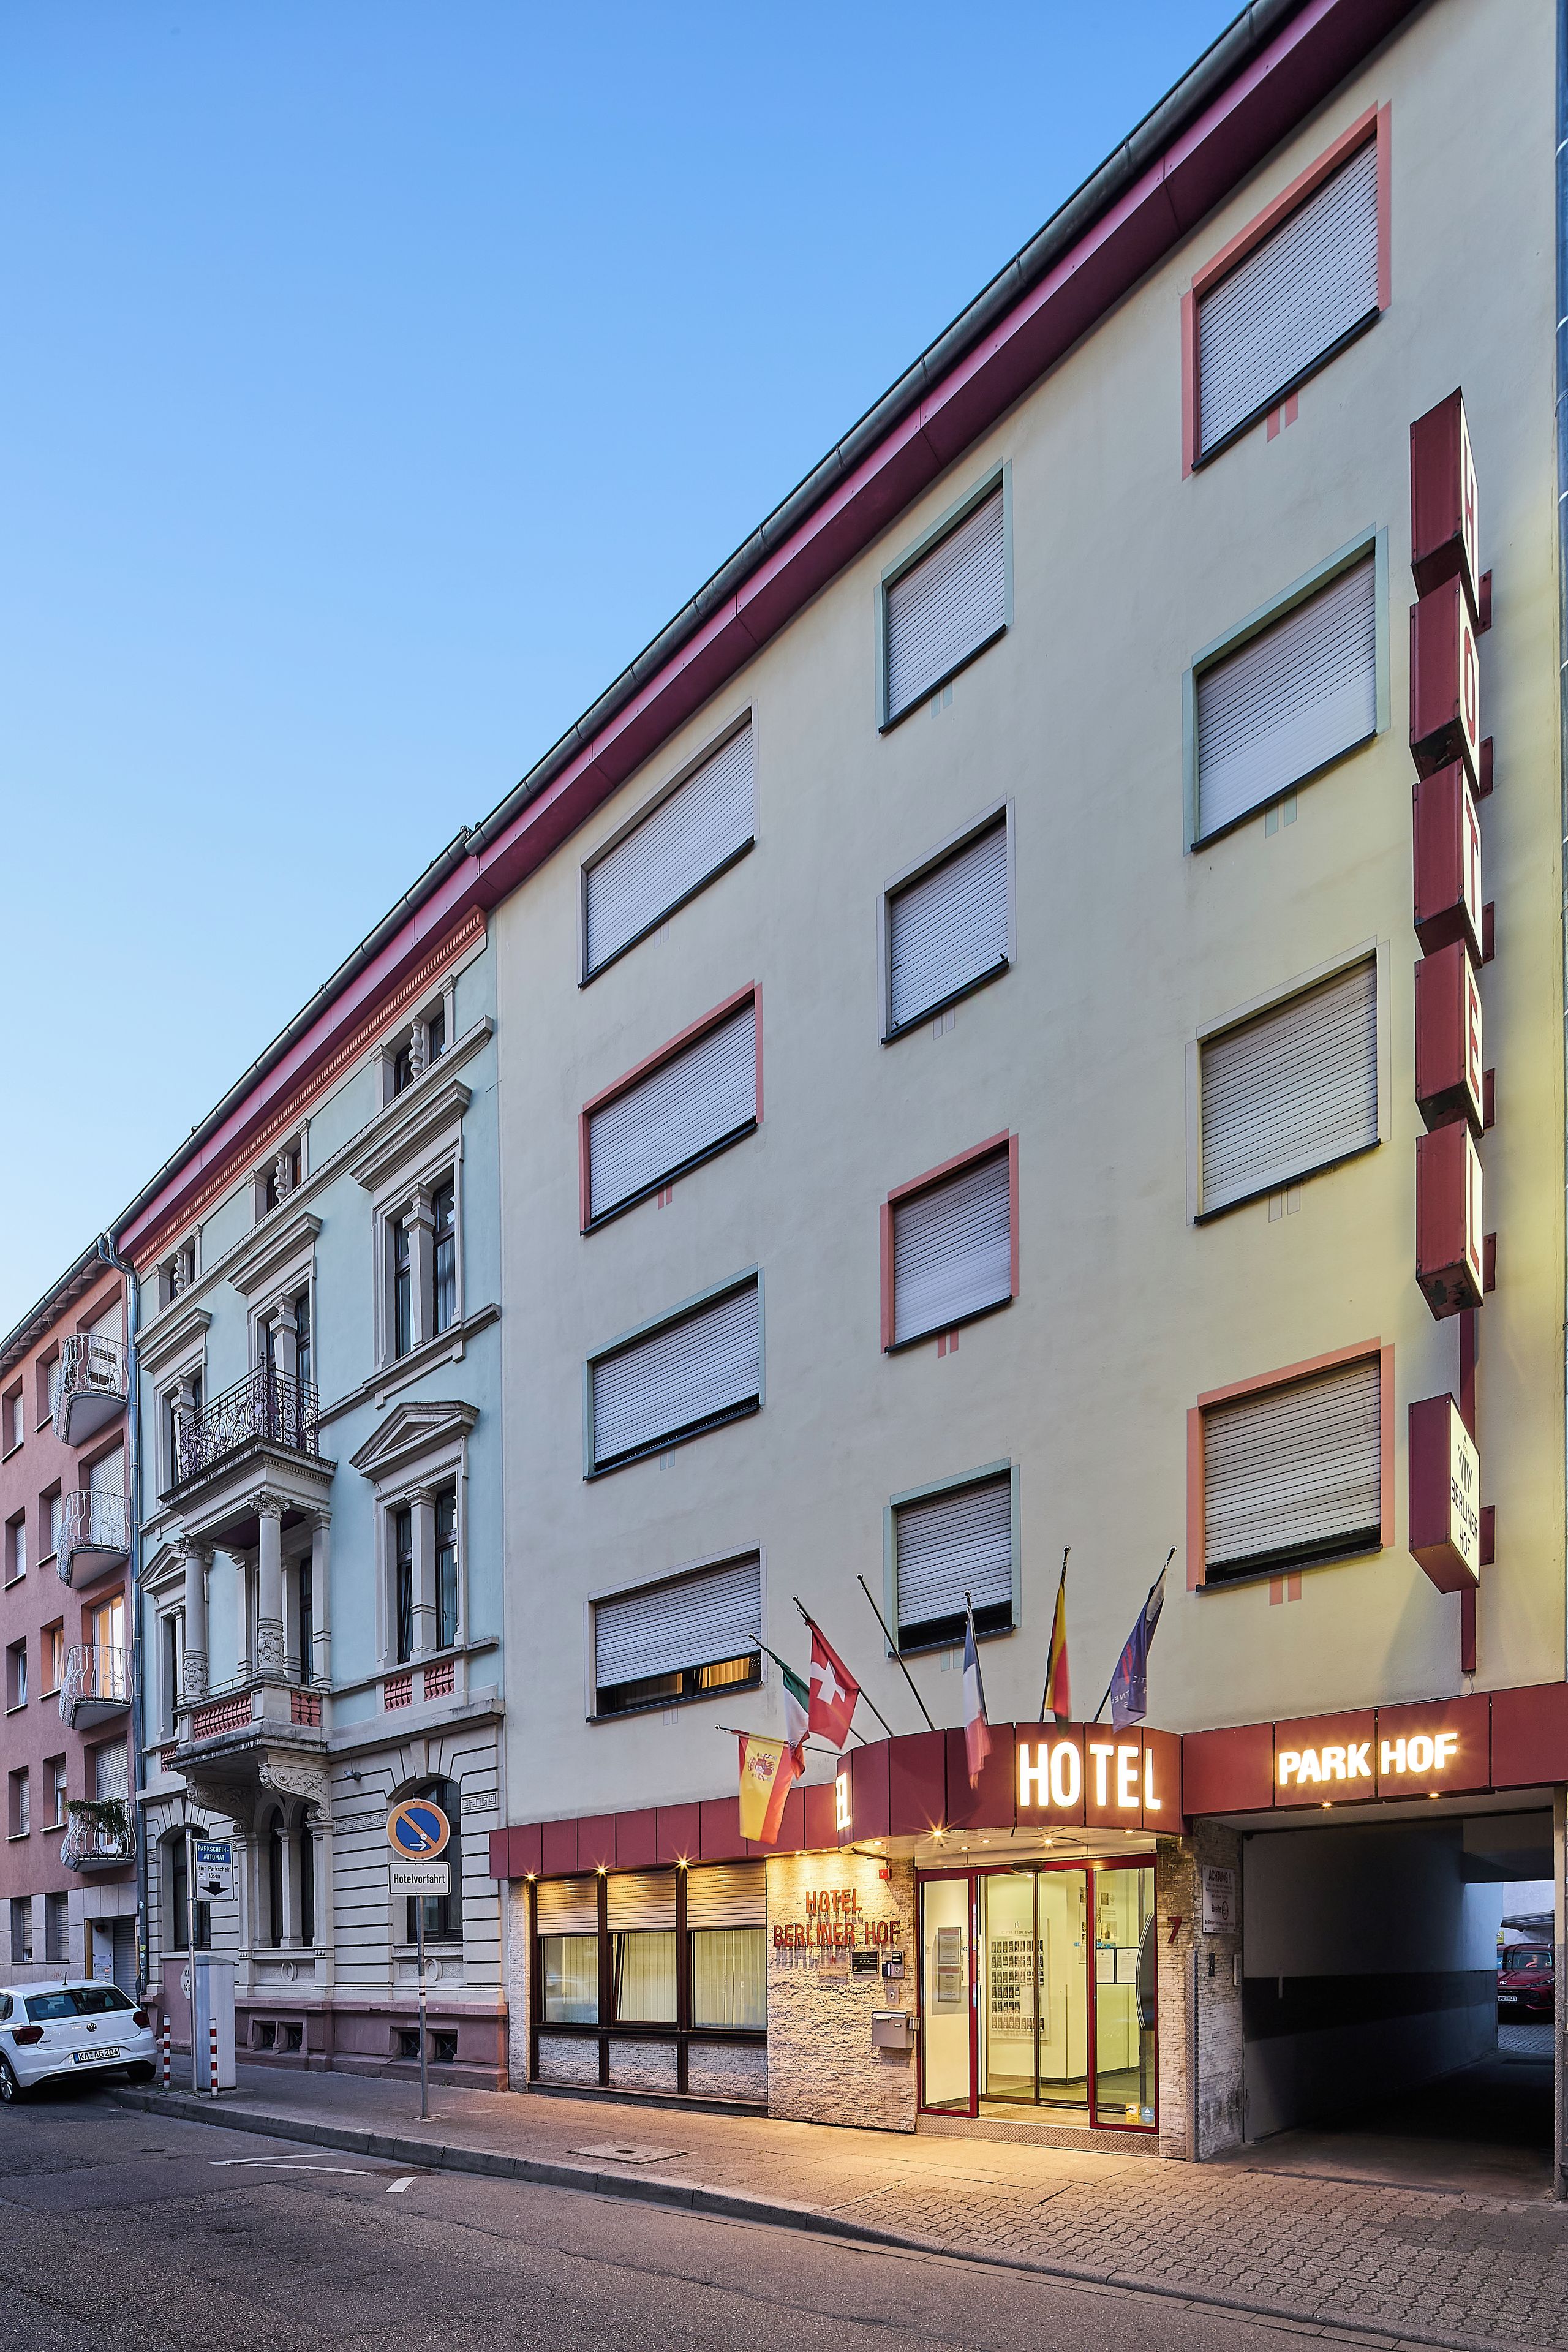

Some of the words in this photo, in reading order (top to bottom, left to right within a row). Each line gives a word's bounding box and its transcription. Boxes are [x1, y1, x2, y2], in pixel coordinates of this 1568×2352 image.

[1451, 1476, 1477, 1542] BERLINER
[1459, 1523, 1471, 1560] HOF
[1278, 1742, 1372, 1785] PARK
[1381, 1732, 1458, 1775] HOF
[1019, 1741, 1161, 1811] HOTEL
[393, 1873, 445, 1884] Hotelvorfahrt
[1208, 1869, 1228, 1883] ACHTUNG
[805, 1888, 863, 1913] HOTEL
[774, 1921, 856, 1947] BERLINER
[864, 1920, 901, 1945] HOF
[1167, 1916, 1182, 1944] 7
